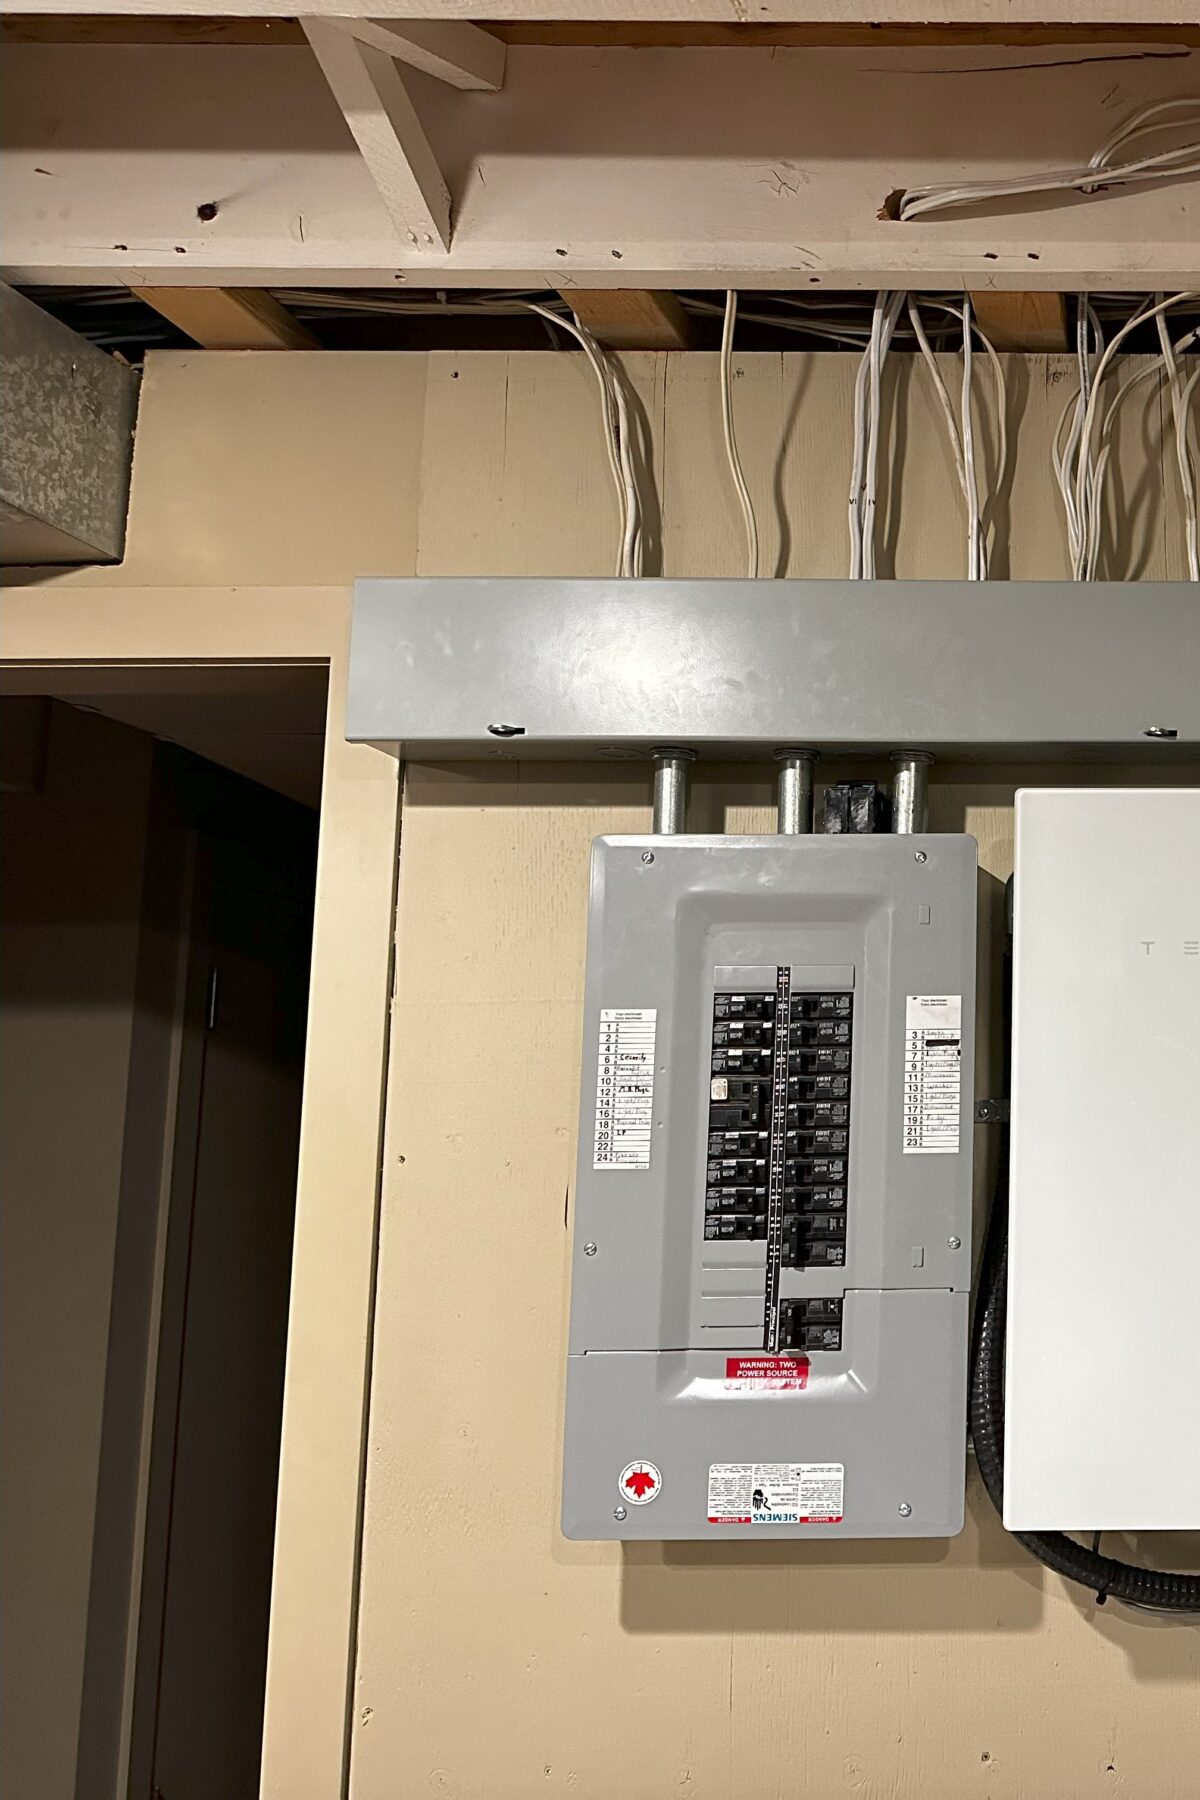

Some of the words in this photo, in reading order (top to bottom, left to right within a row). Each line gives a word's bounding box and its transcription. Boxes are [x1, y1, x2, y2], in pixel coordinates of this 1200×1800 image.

[605, 1034, 611, 1042] 2
[912, 1031, 918, 1039] 3
[912, 1042, 918, 1050] 5
[604, 1056, 610, 1064] 6
[912, 1052, 917, 1060] 7
[911, 1063, 917, 1071] 9
[601, 1077, 611, 1085] 10
[600, 1088, 611, 1096] 12
[908, 1084, 918, 1092] 13
[600, 1099, 610, 1107] 14
[599, 1110, 610, 1118] 16
[599, 1121, 609, 1129] 18
[907, 1127, 917, 1135] 21
[598, 1132, 609, 1140] 20
[907, 1138, 918, 1146] 23
[597, 1142, 609, 1151] 22
[597, 1153, 608, 1161] 24
[753, 1513, 798, 1522] SIEMENS
